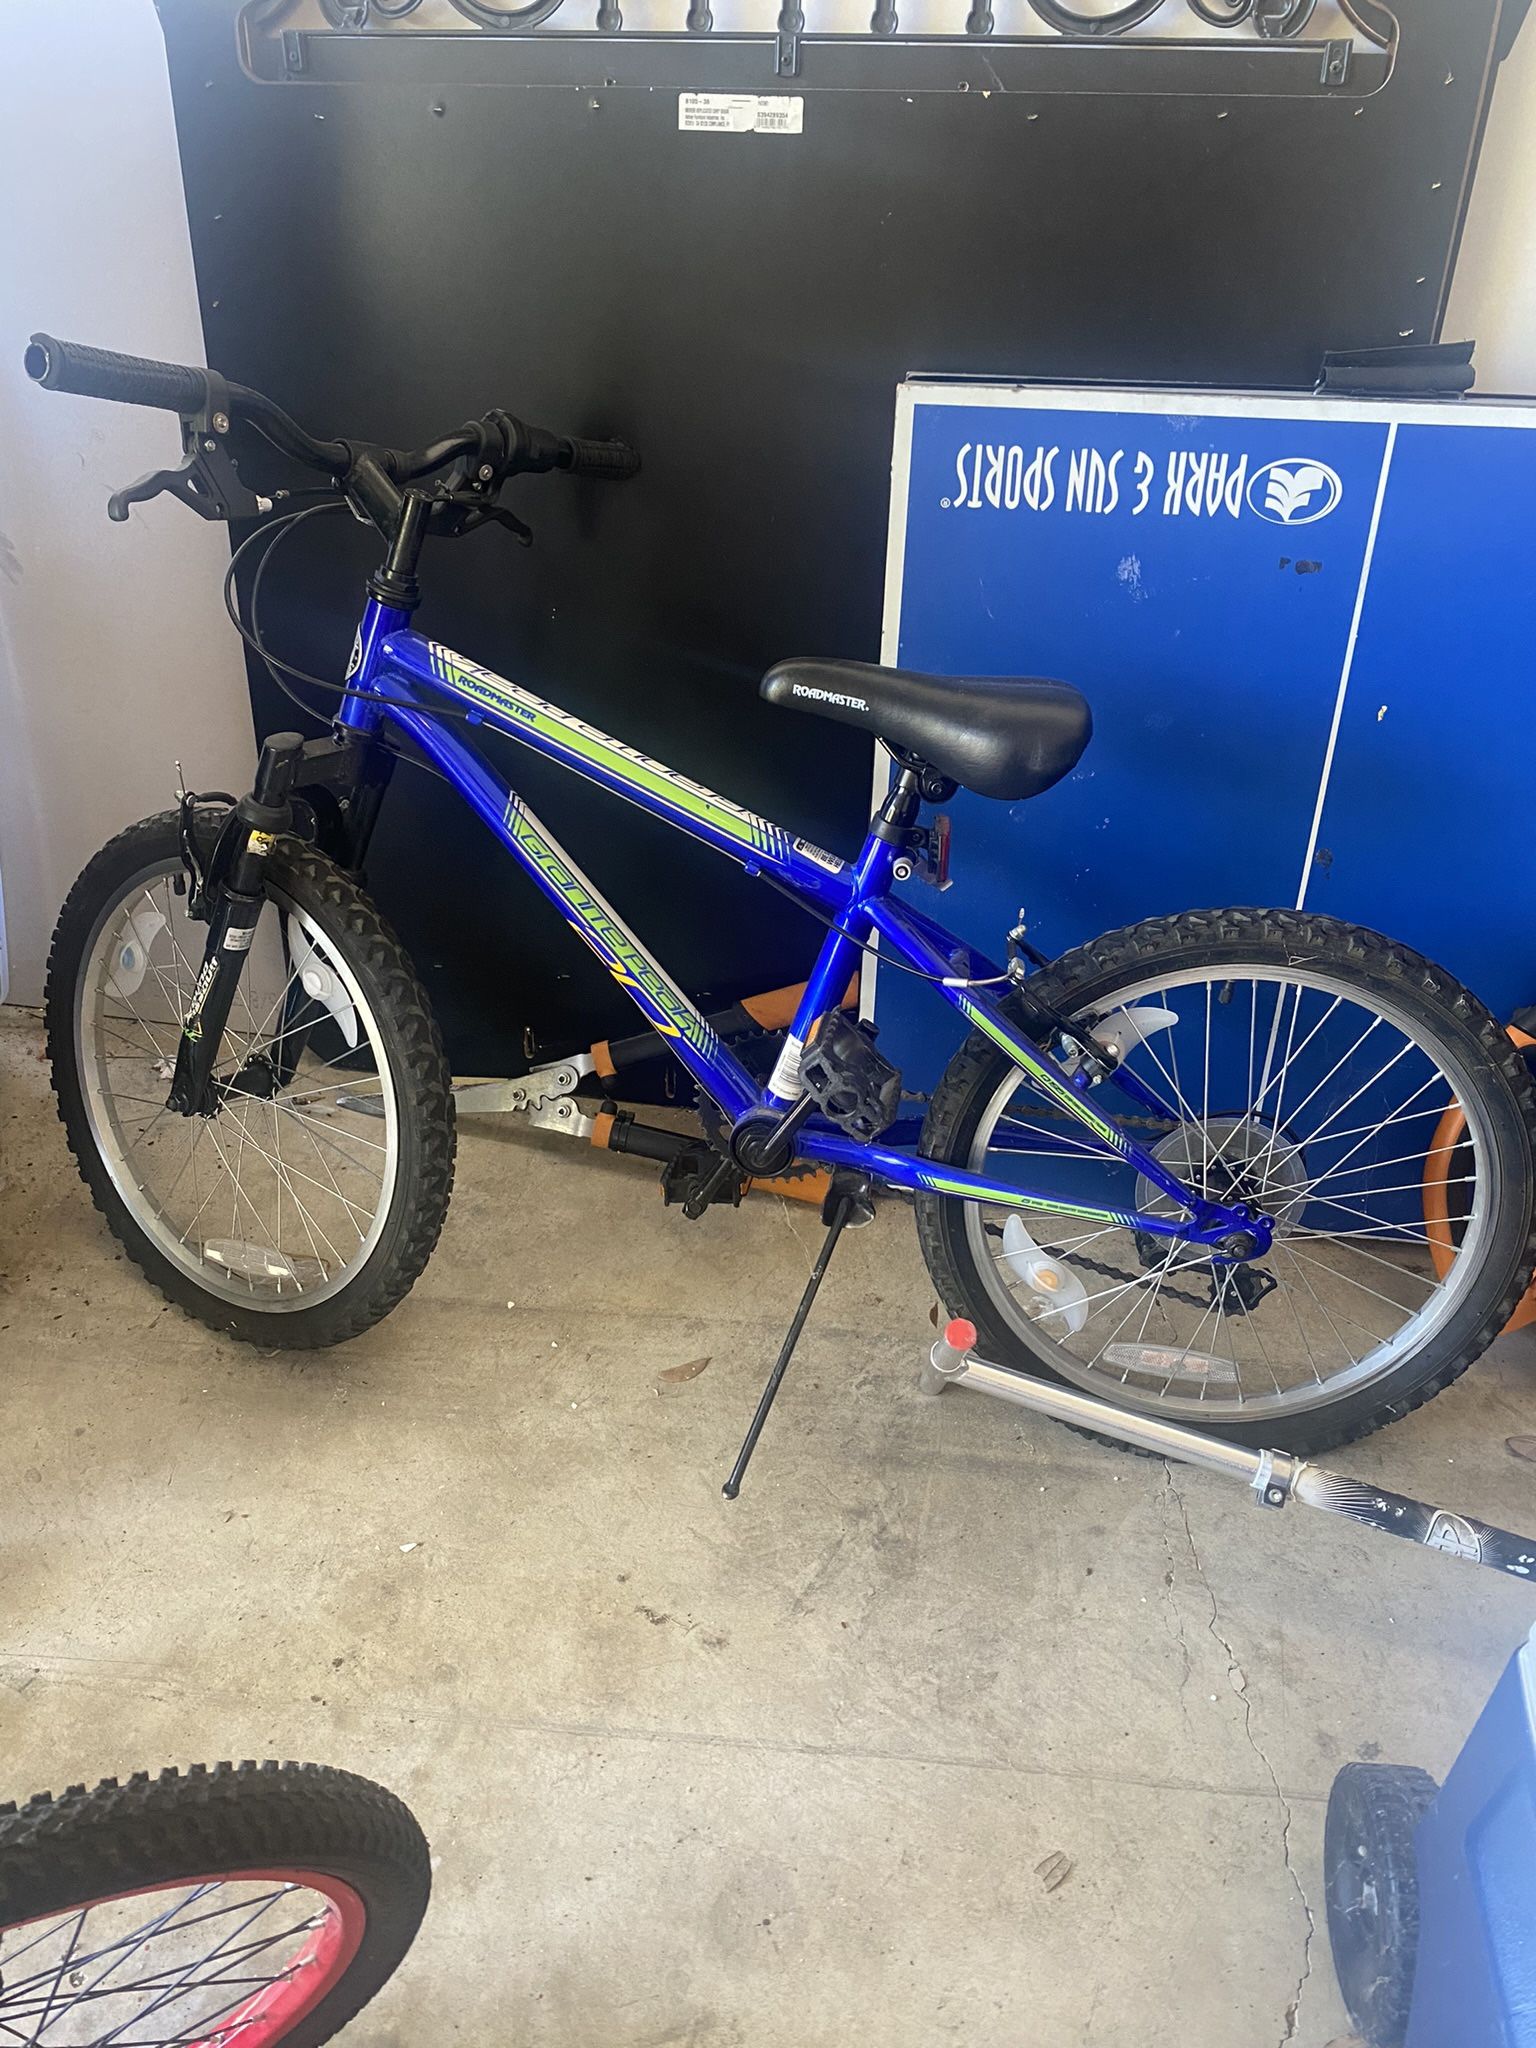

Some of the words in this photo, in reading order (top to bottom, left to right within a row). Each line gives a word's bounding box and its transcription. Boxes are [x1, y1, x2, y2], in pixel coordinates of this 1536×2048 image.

[953, 442, 1060, 512] SPORTS
[1065, 447, 1124, 516] SUN
[1131, 450, 1155, 516] &
[1163, 451, 1249, 519] PARK
[457, 674, 537, 723] ROADMASTER
